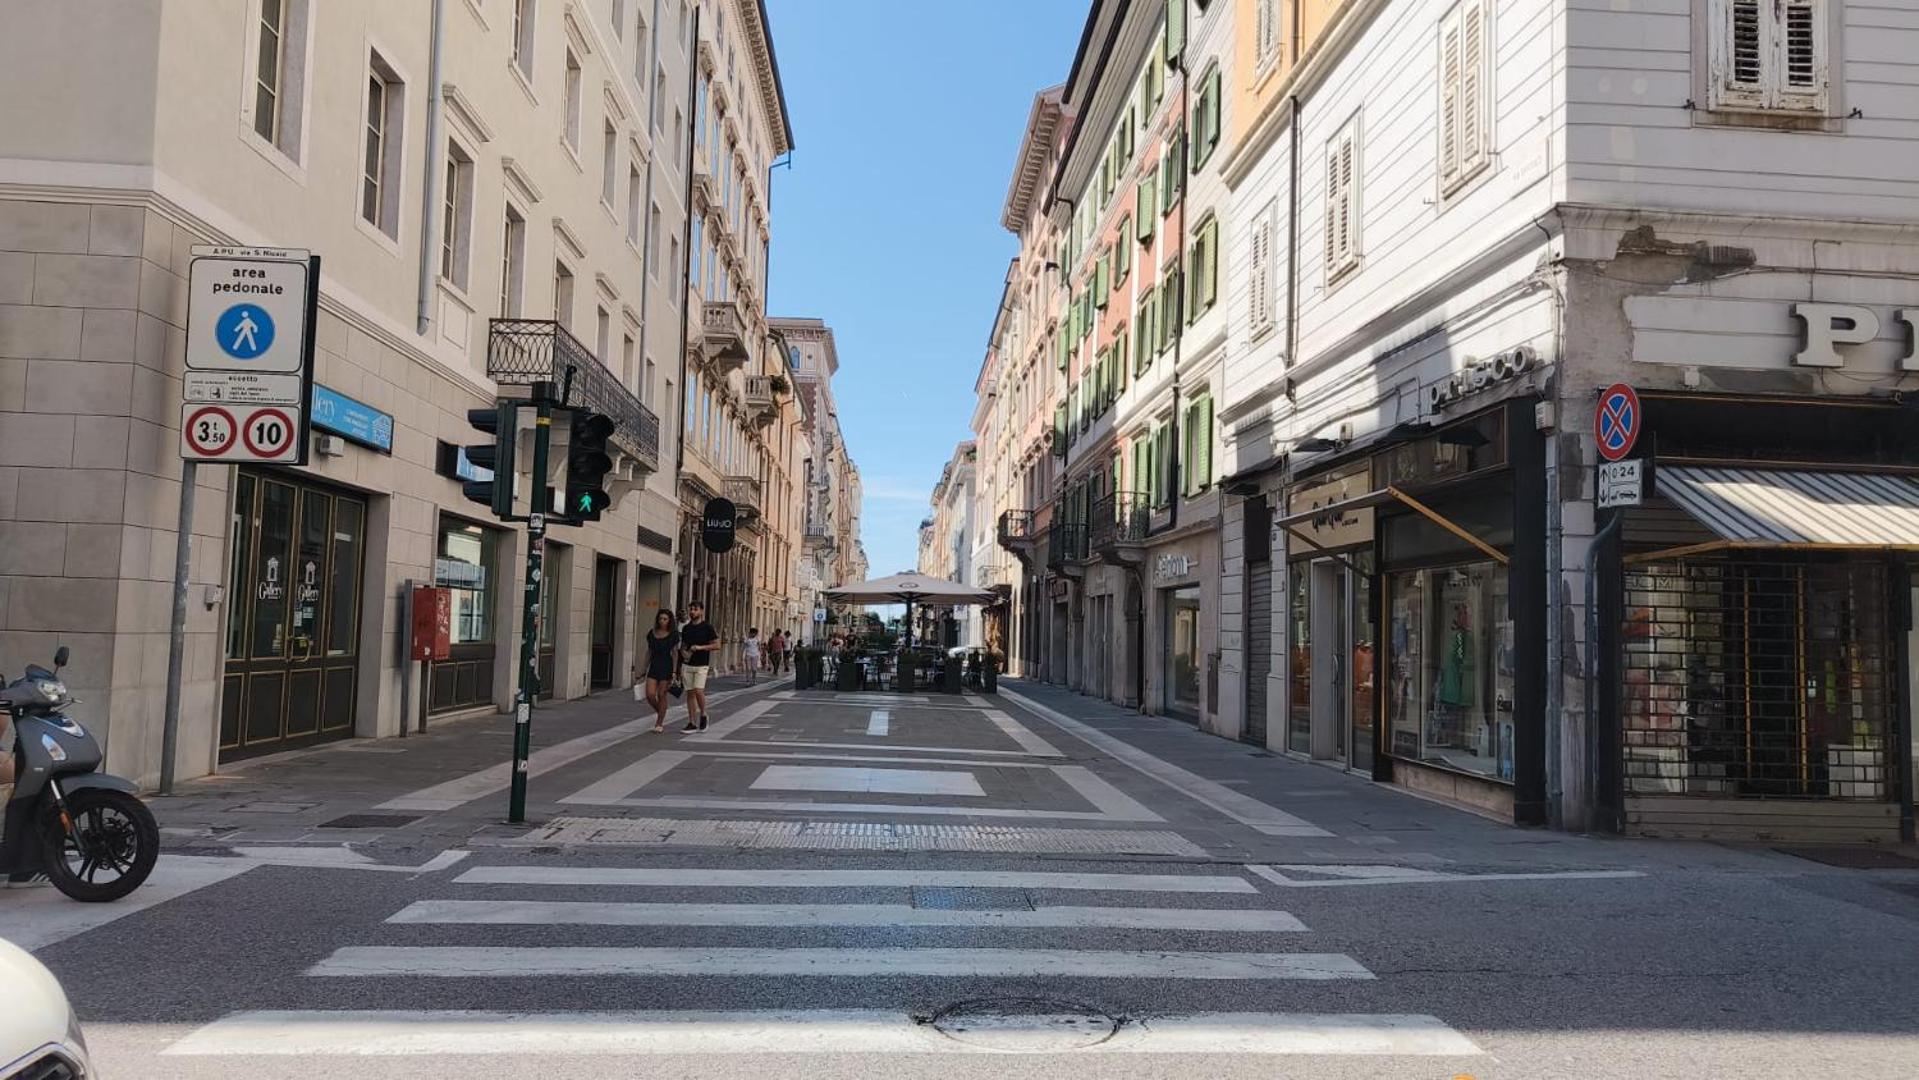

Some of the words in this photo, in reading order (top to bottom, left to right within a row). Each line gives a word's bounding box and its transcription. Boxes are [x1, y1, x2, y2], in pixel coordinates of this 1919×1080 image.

[232, 268, 266, 279] area
[212, 282, 284, 295] pedonale
[1788, 302, 1919, 371] P
[256, 422, 282, 446] 10
